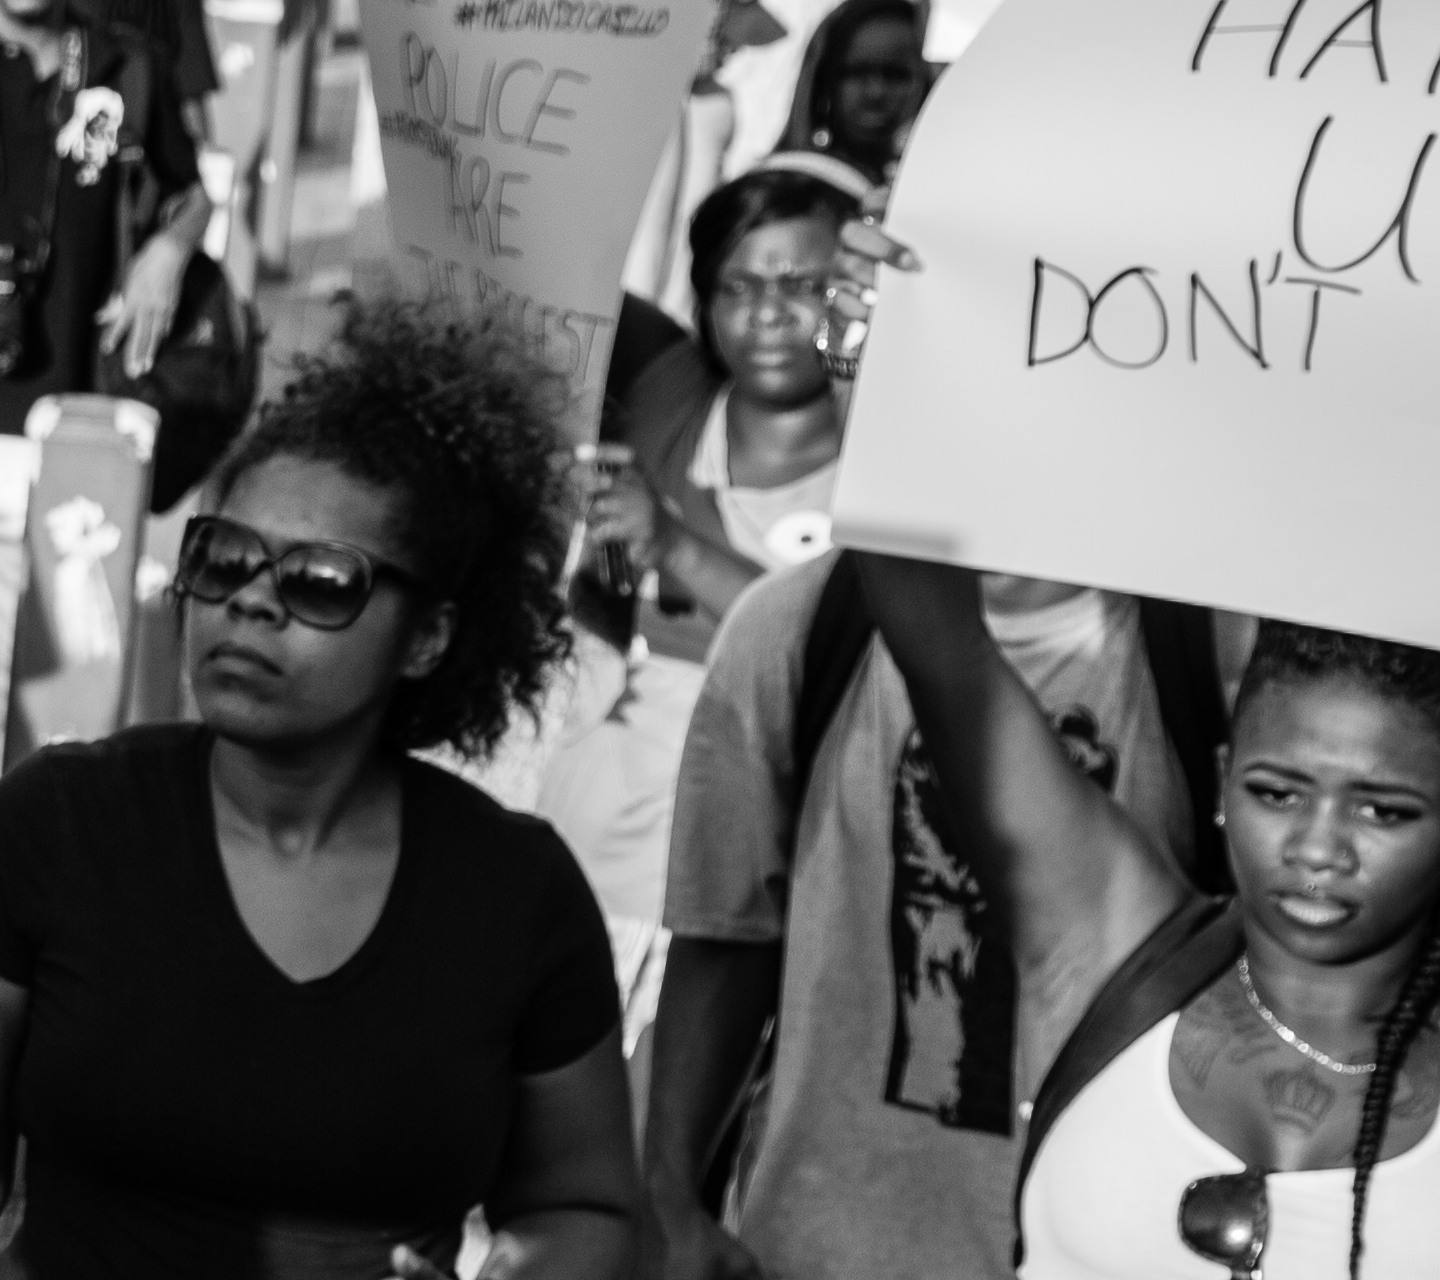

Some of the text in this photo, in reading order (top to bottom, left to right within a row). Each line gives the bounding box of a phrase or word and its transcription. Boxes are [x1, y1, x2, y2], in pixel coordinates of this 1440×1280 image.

[399, 29, 592, 156] POLICE
[444, 147, 531, 258] ARE
[1025, 249, 1364, 373] DON'T
